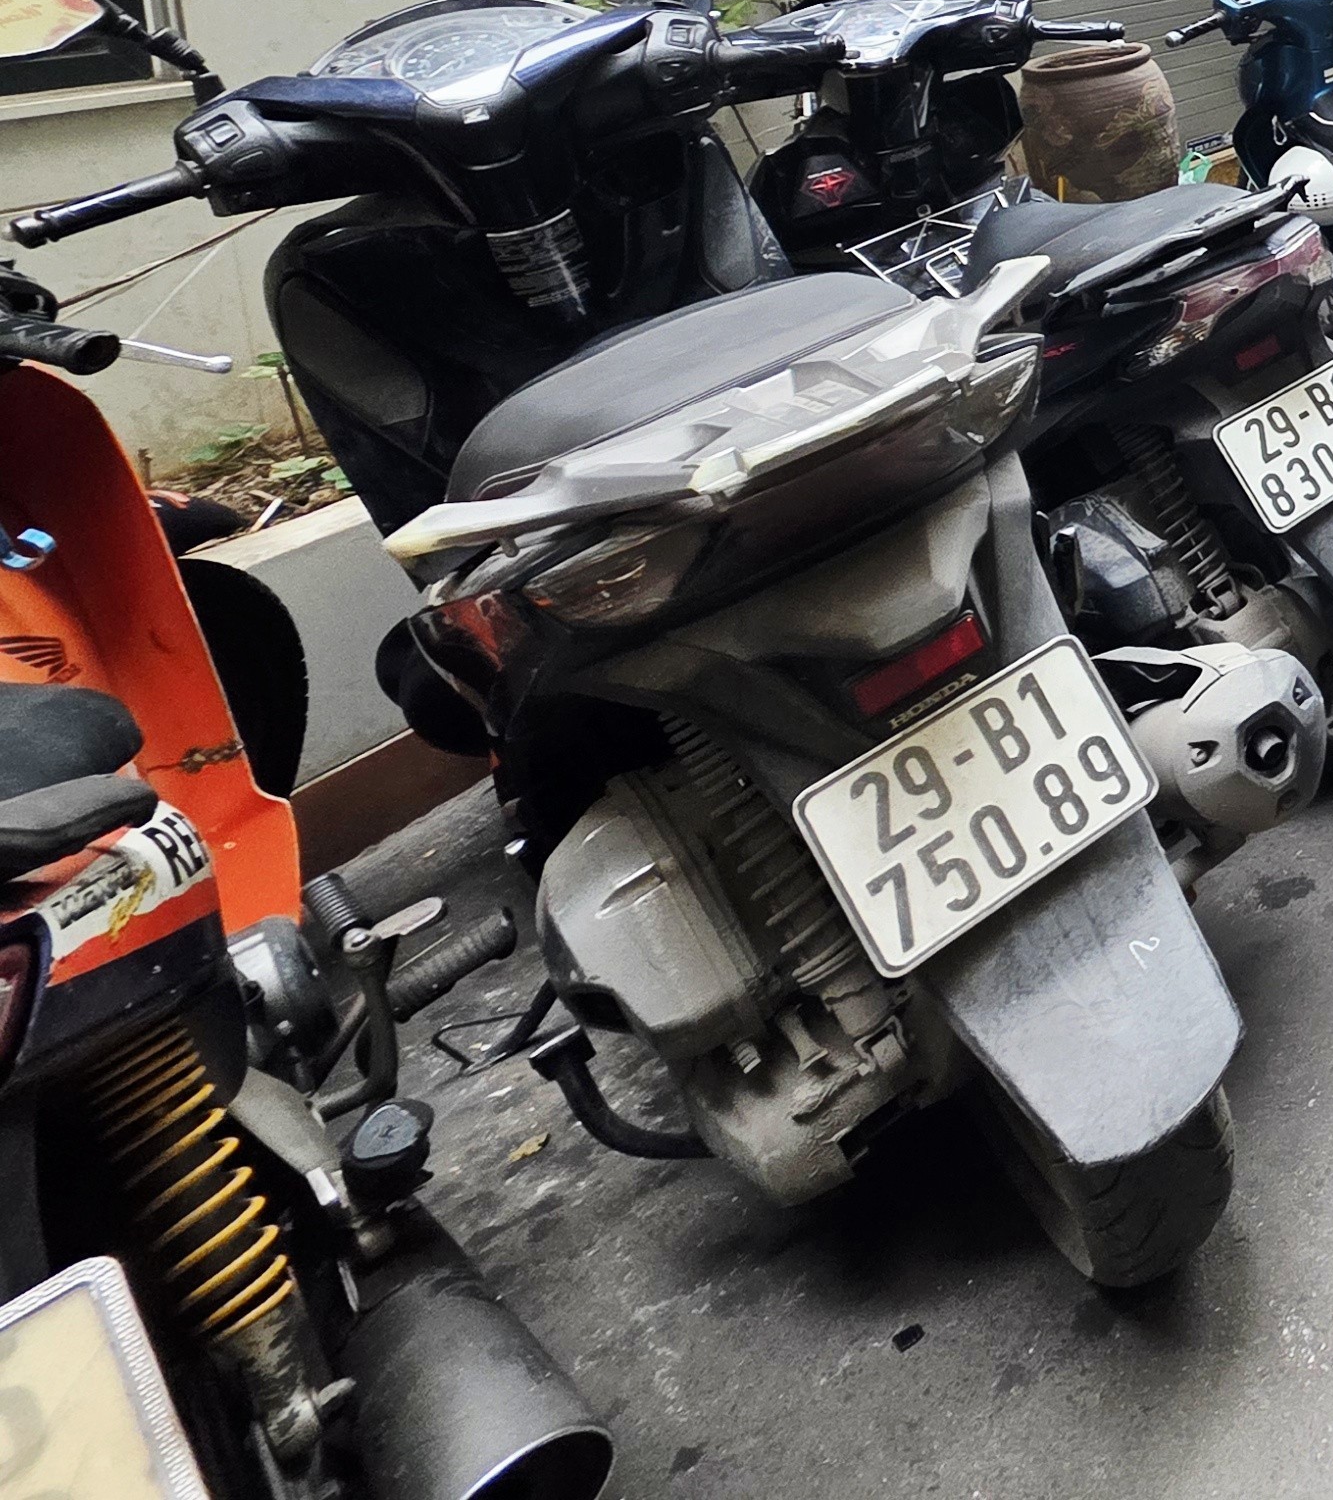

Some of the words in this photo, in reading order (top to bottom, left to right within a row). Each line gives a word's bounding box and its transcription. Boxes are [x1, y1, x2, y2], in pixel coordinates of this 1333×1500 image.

[849, 671, 1067, 854] 29-B1
[888, 672, 978, 730] HONDA
[865, 735, 1132, 953] 750.89
